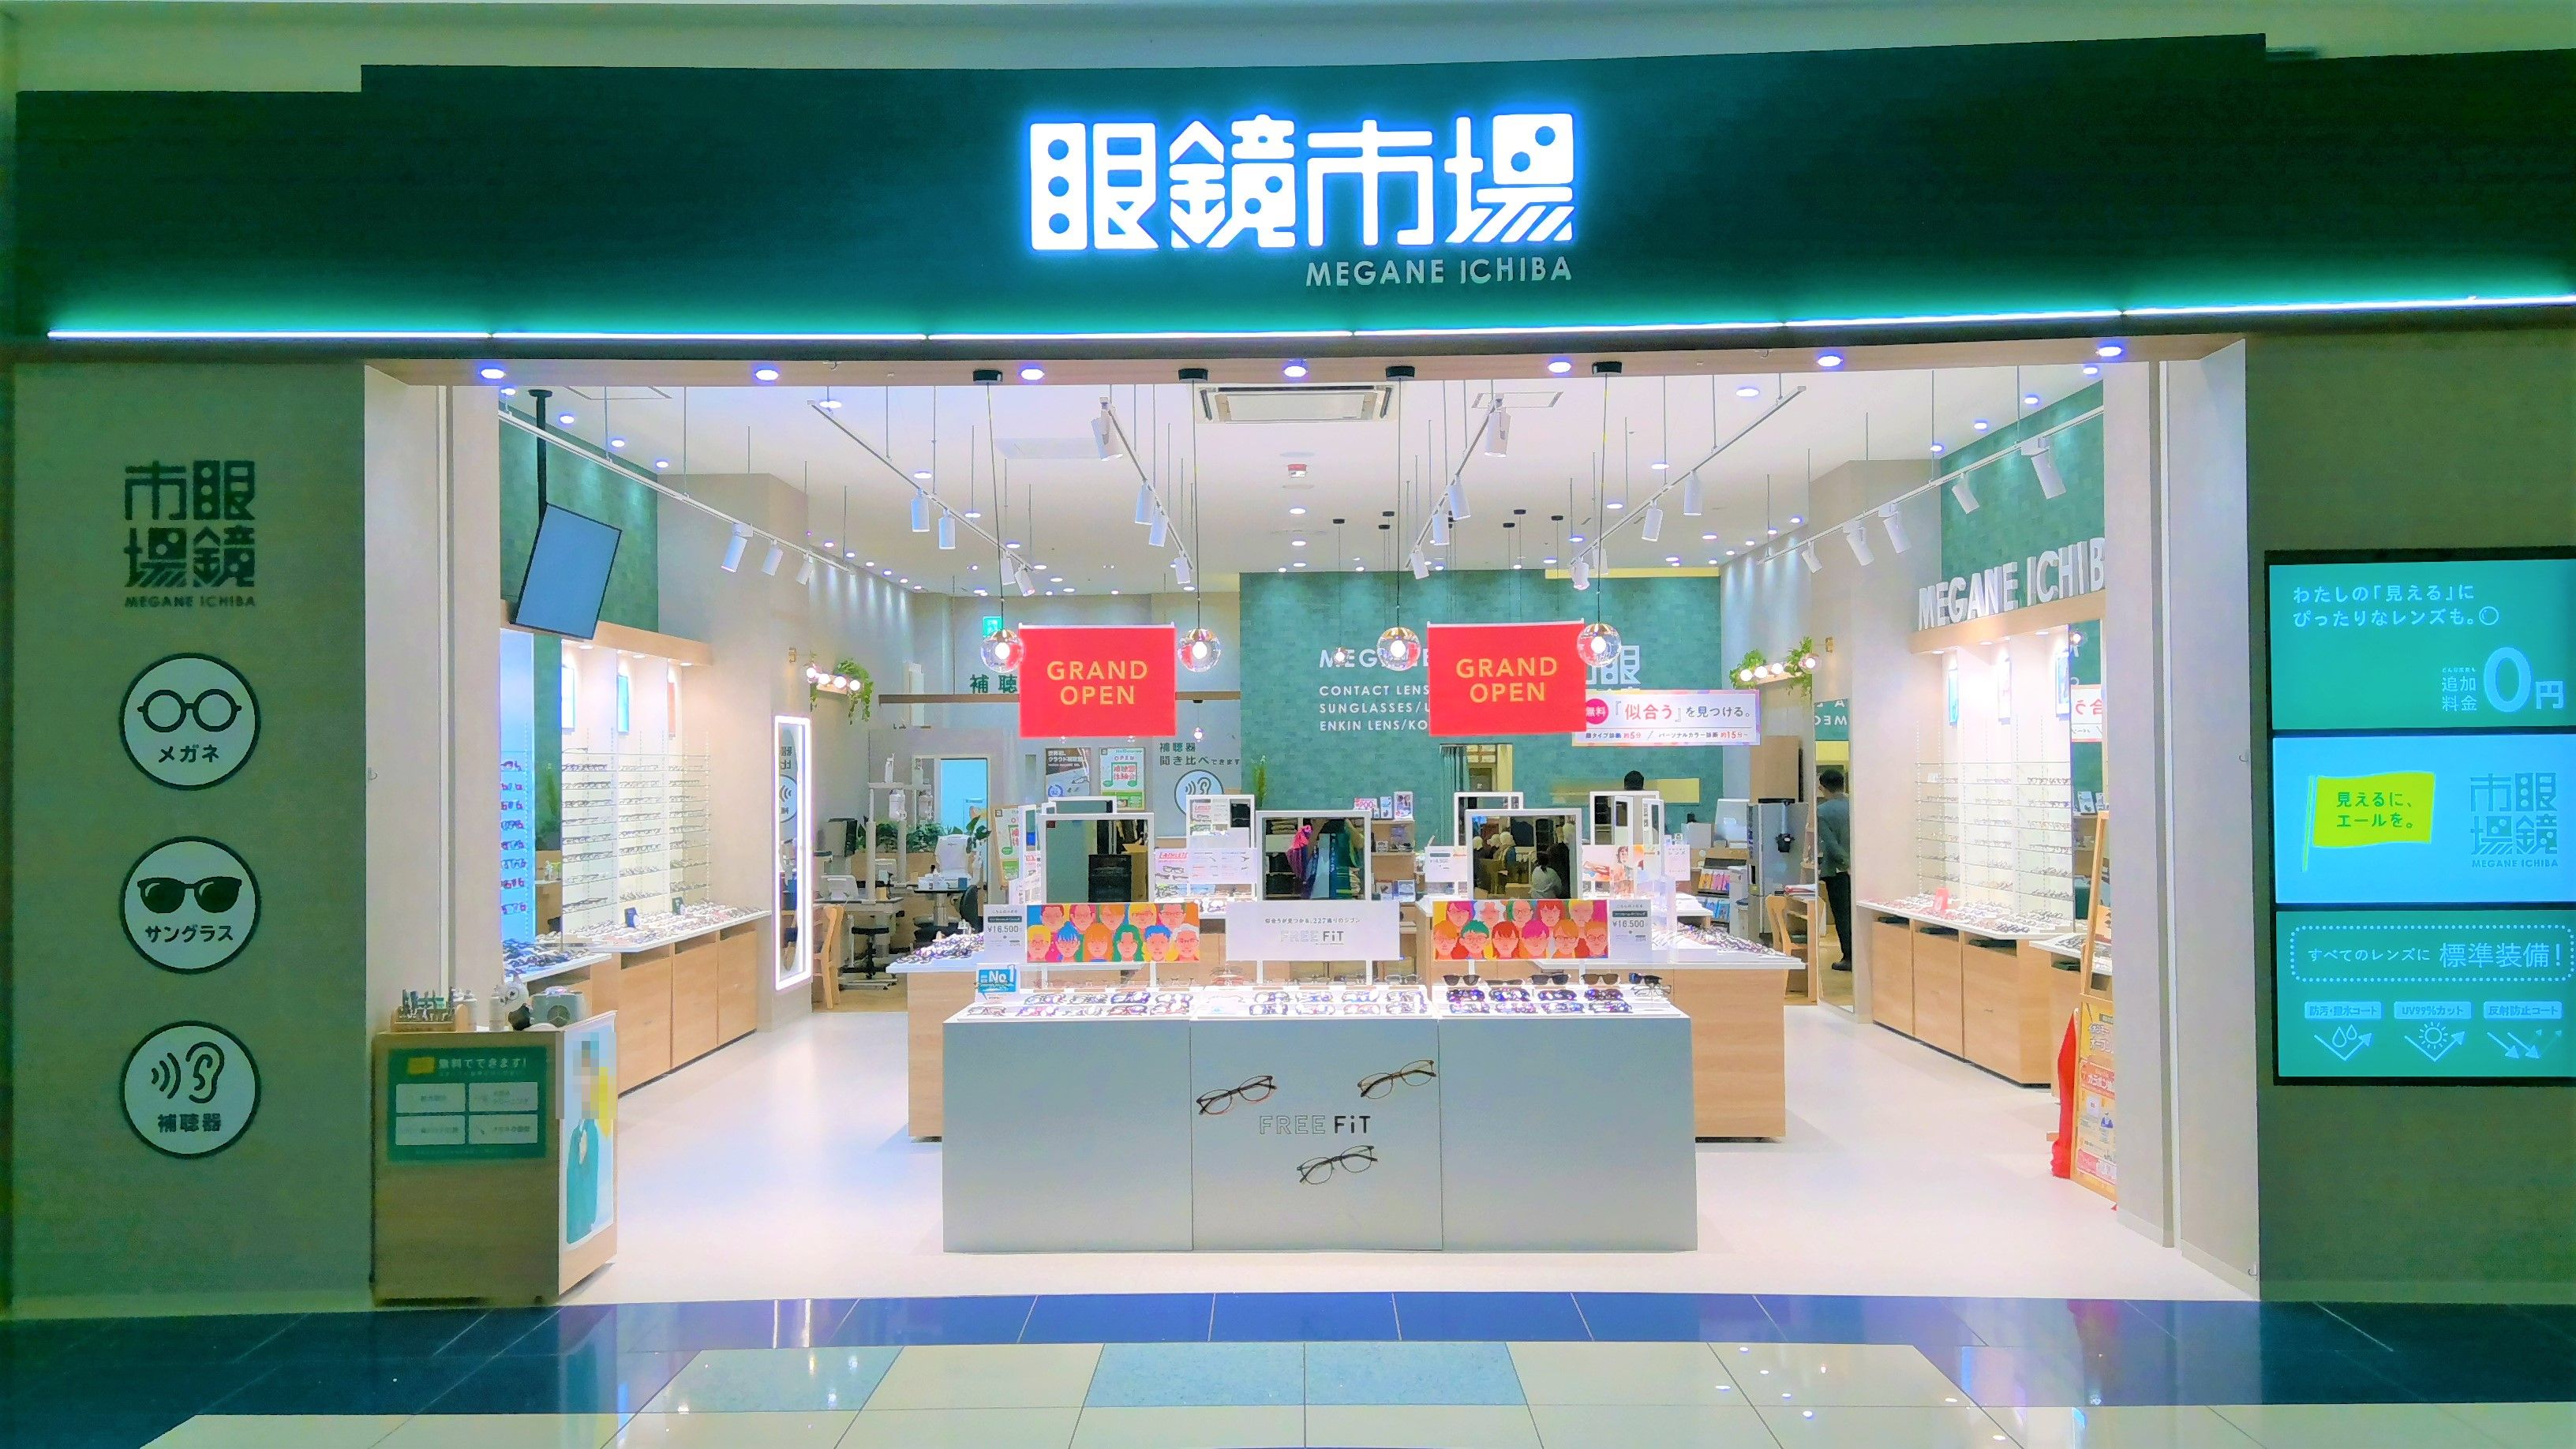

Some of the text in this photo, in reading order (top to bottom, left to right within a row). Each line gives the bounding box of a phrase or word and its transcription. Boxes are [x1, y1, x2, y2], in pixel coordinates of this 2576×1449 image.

[1030, 114, 1574, 250] 眼鏡市場
[1306, 256, 1573, 286] MEGANE ICHIBA
[124, 595, 256, 608] MEGANE ICHIBA
[1919, 561, 2019, 631] MEGANE
[2293, 584, 2475, 604] わたしの「見える」に
[1046, 660, 1148, 681] GRAND
[1455, 657, 1558, 679] GRAND
[2441, 676, 2477, 692] 追加
[2483, 646, 2565, 713] 0円
[1060, 685, 1136, 706] OPEN
[1319, 685, 1390, 696] CONTACT
[1469, 681, 1546, 703] OPEN
[2442, 695, 2477, 712] 料金
[1320, 720, 1361, 732] ENKIN
[158, 744, 219, 763] メガネ
[2336, 792, 2412, 807] 見えるに、
[2336, 812, 2413, 829] エールを。
[2471, 859, 2559, 868] MEGANE ICHIBA
[144, 924, 234, 943] サングラス
[2307, 942, 2562, 969] すべてのレンズに 標準装備!
[2402, 1005, 2463, 1017] UV99%カット
[2488, 1005, 2559, 1017] 反射防止コート
[157, 1113, 222, 1133] 補聴器
[1259, 1114, 1371, 1135] FREE FiT
